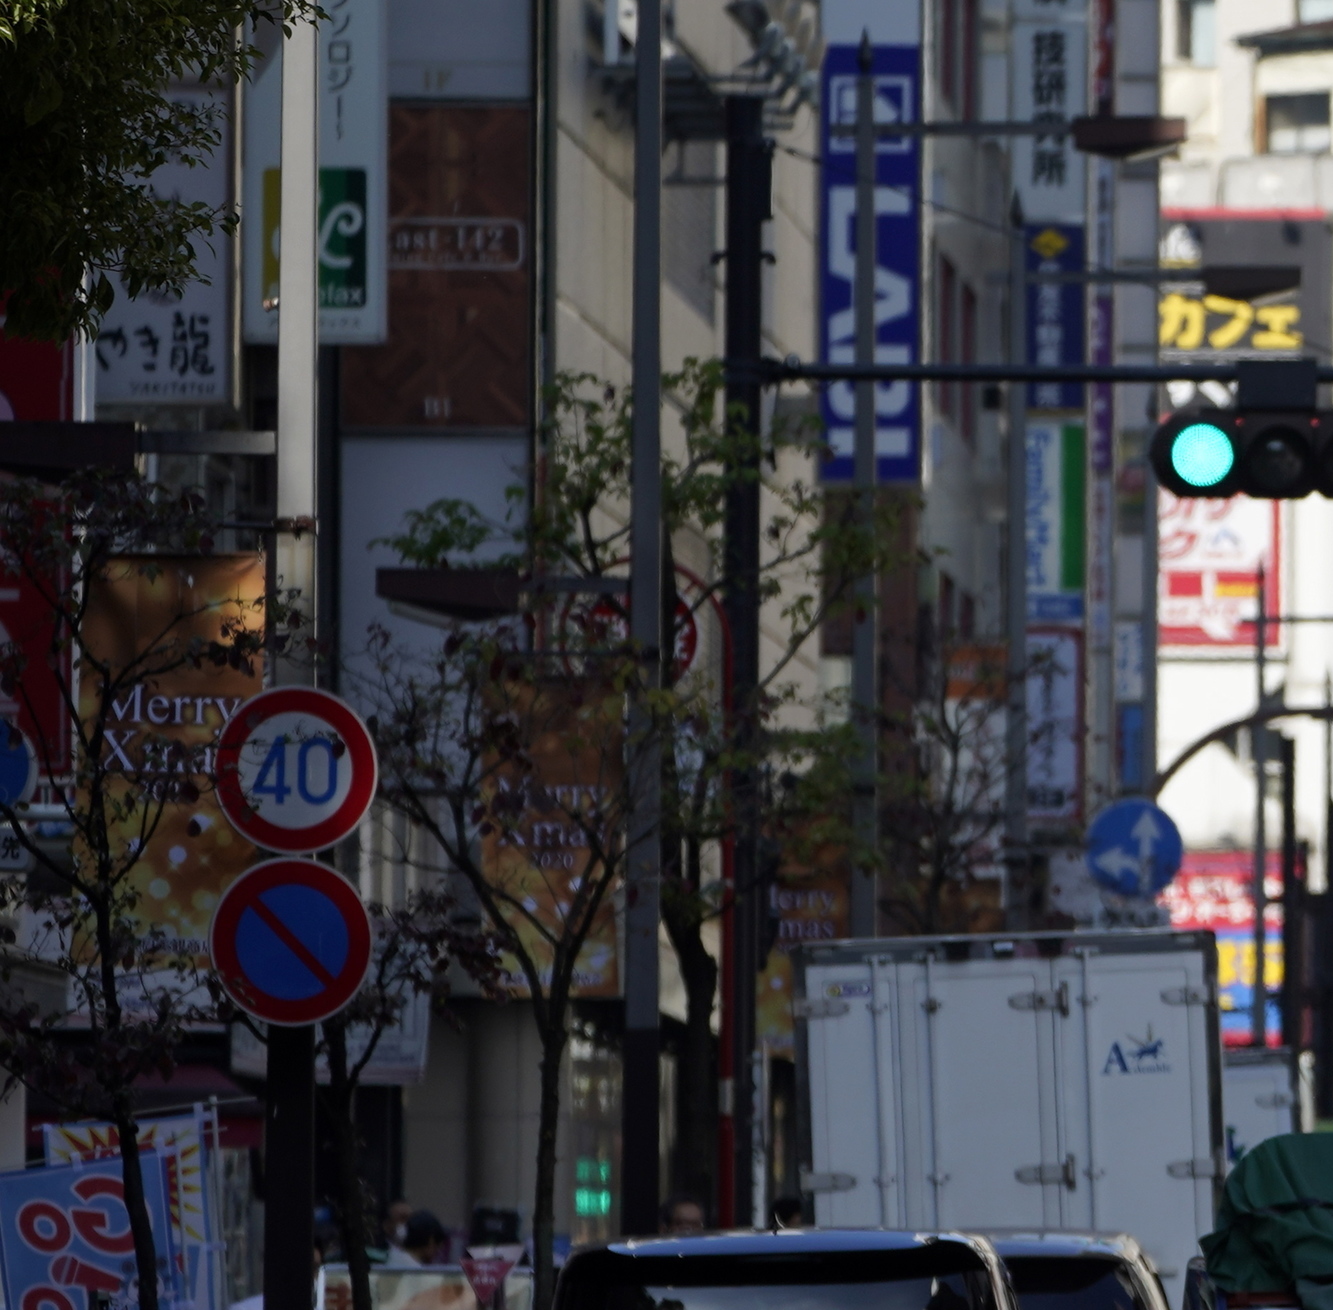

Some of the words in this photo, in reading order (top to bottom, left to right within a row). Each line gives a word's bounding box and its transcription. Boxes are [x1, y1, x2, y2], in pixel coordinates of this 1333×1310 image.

[1158, 293, 1303, 350] カフェ
[252, 735, 338, 805] 40
[768, 881, 835, 916] erry
[776, 916, 835, 940] mas
